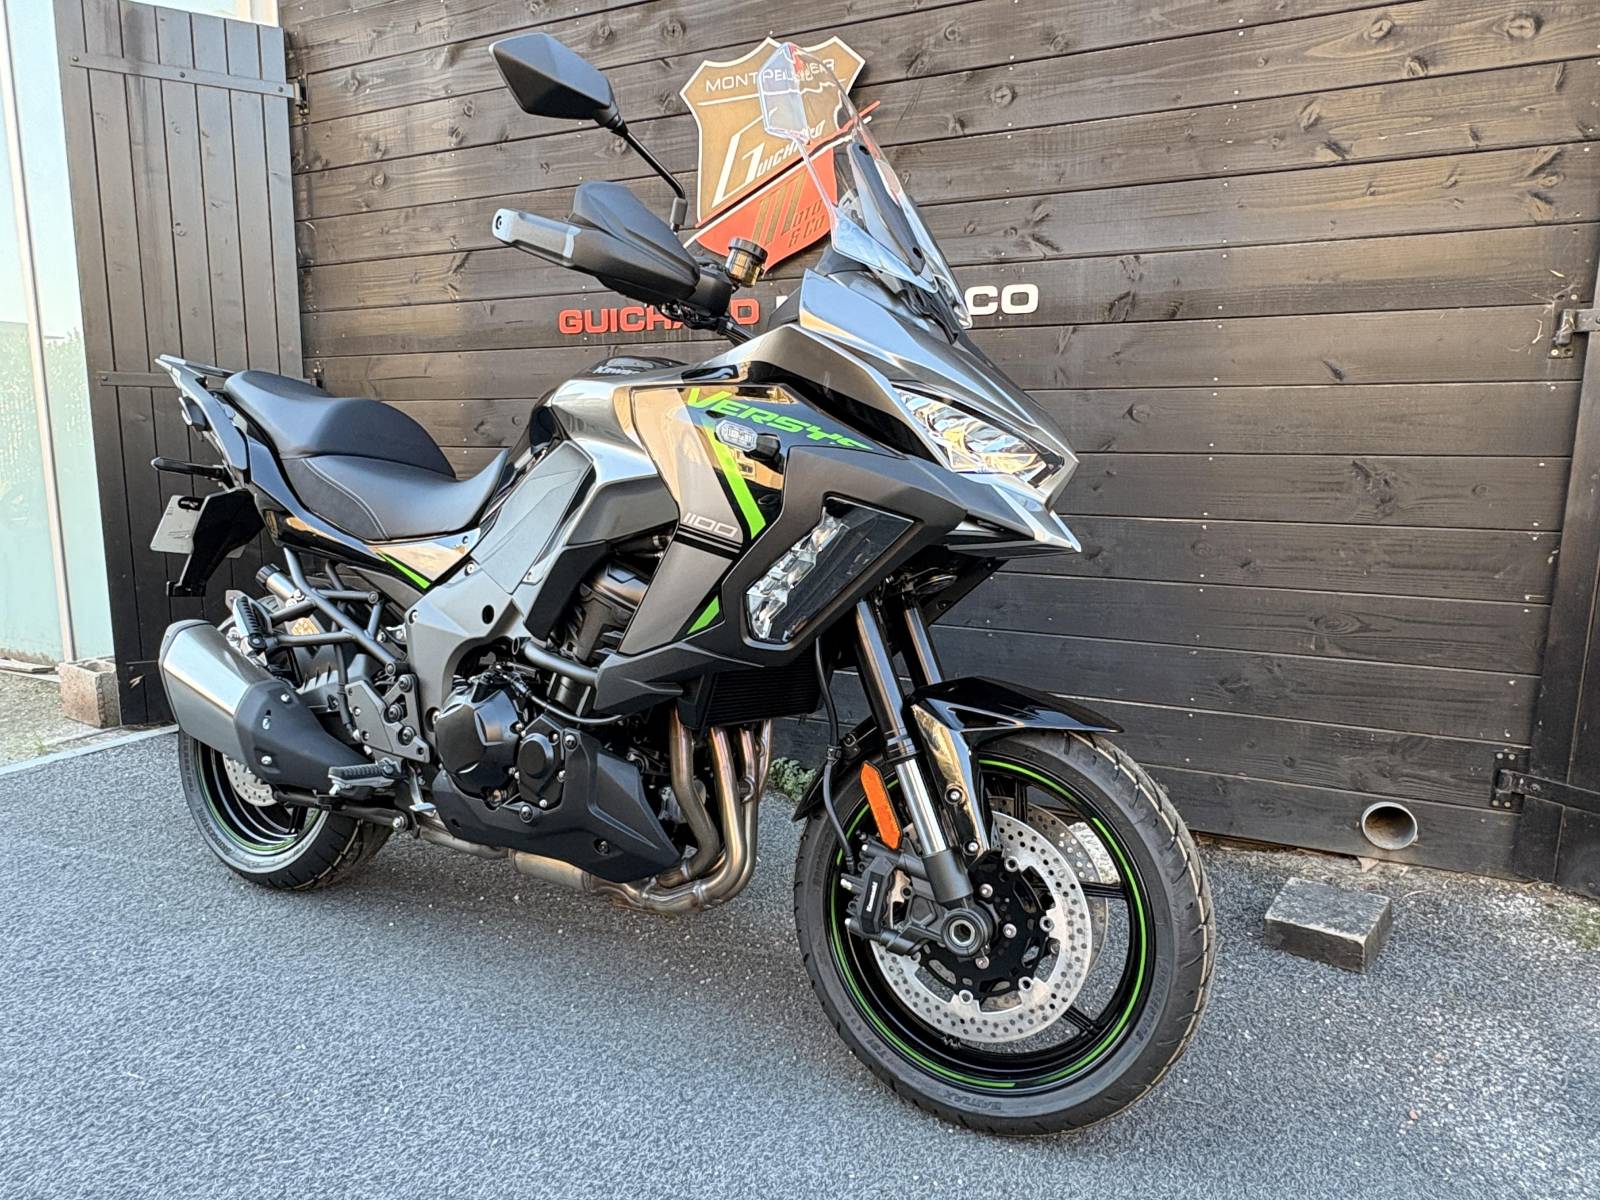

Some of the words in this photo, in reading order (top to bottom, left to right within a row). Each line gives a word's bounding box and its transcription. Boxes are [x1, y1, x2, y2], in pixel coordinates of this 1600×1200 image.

[712, 106, 826, 208] GUICHD
[558, 297, 761, 335] GUICHD
[964, 282, 1040, 316] CO
[683, 511, 739, 538] 1100
